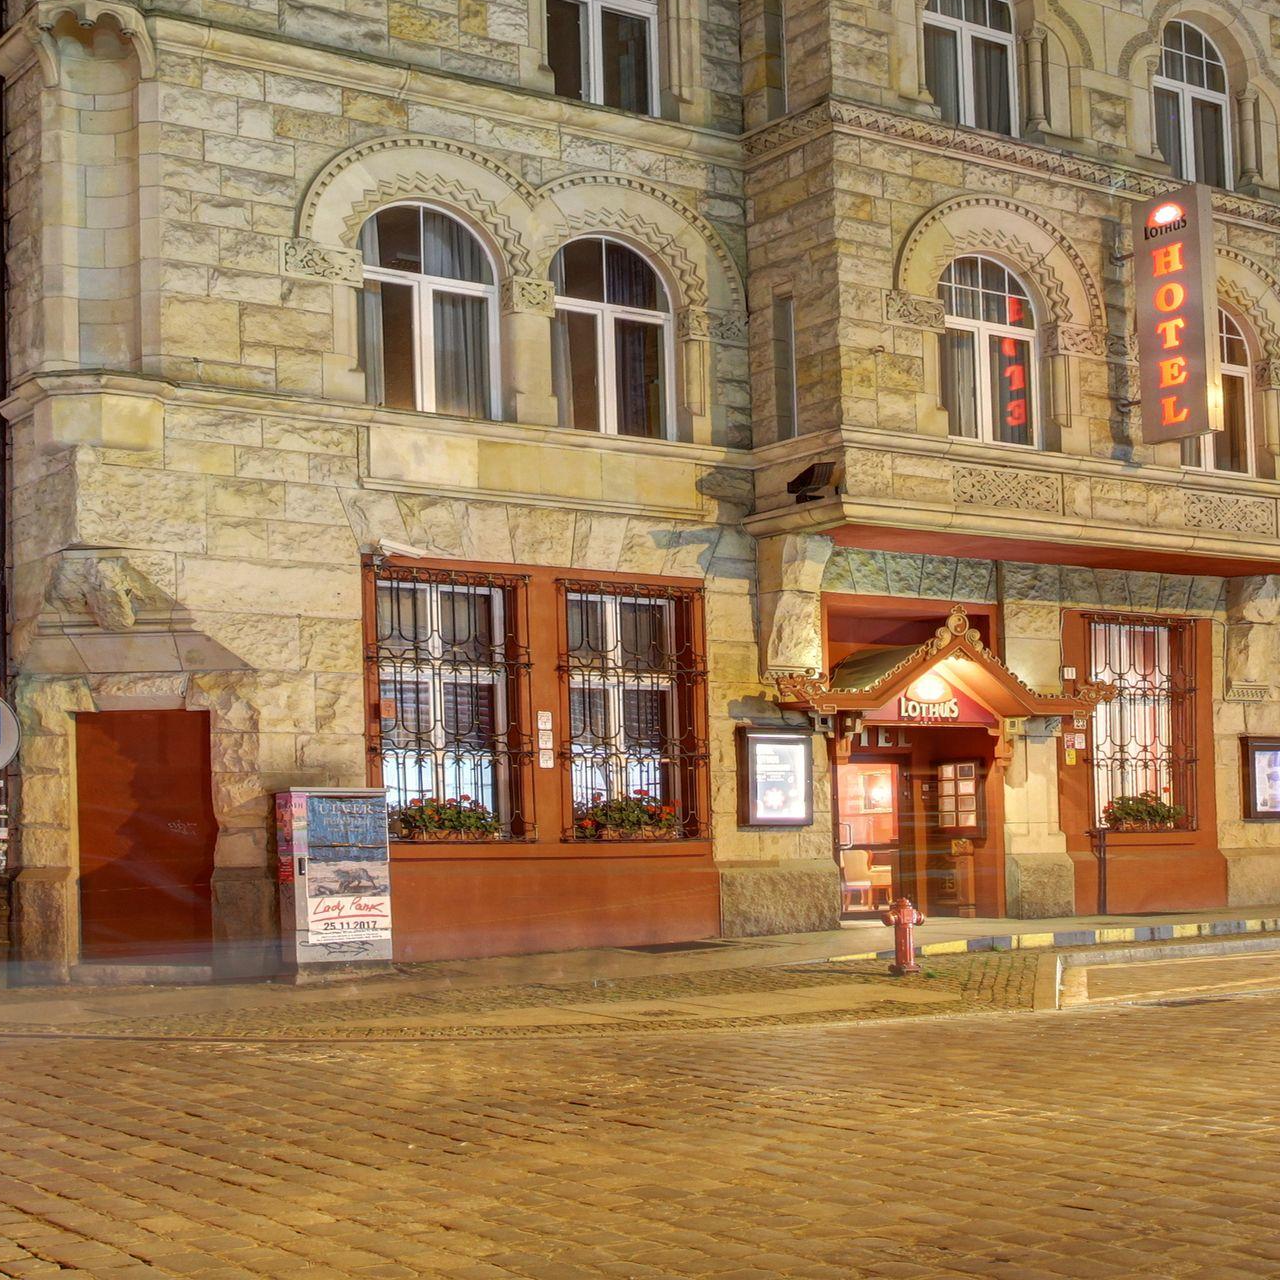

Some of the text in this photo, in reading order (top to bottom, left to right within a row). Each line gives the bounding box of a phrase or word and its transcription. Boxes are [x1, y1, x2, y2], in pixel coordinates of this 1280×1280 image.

[1151, 242, 1191, 426] HOTEL
[900, 696, 959, 718] LOTHUS
[314, 898, 345, 916] Lady
